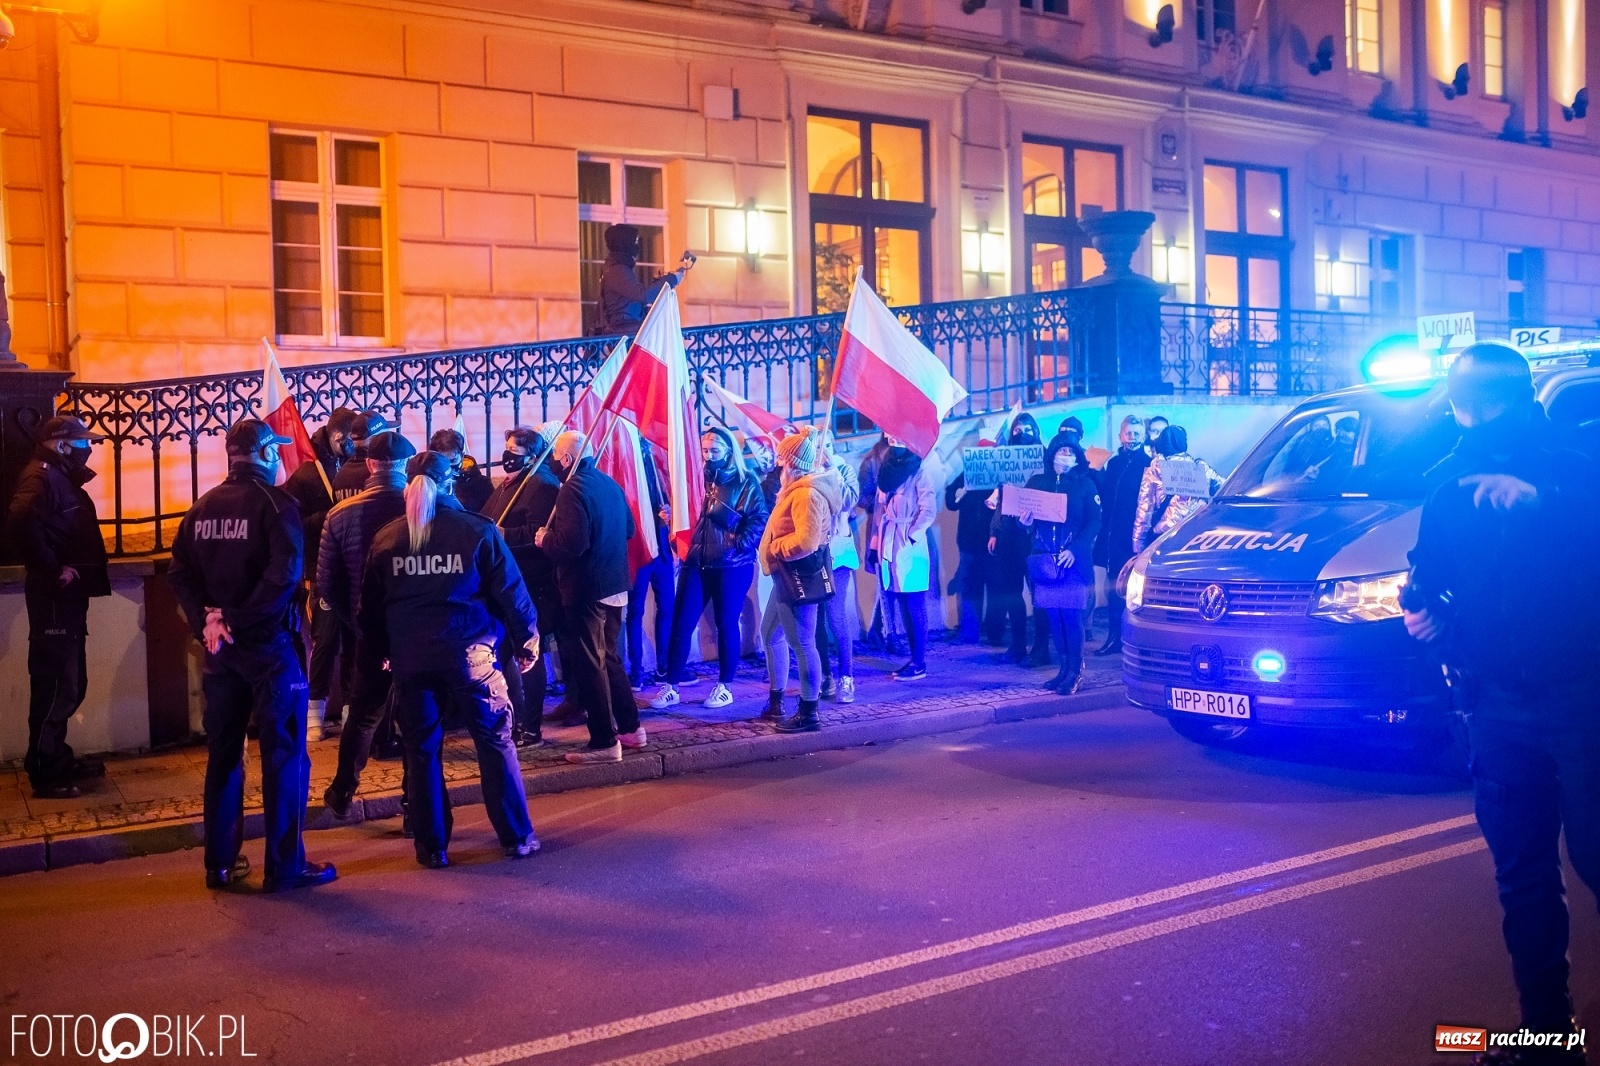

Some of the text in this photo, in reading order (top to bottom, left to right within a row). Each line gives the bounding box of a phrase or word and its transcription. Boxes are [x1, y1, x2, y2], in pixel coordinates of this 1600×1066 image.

[1422, 317, 1473, 338] WOLNA
[998, 448, 1011, 460] TO
[1014, 447, 1043, 460] TWOJA
[992, 461, 1020, 472] TWOJA
[1004, 473, 1026, 484] WINA
[195, 518, 249, 541] POLICJA
[1180, 531, 1309, 553] POLICJA
[392, 553, 464, 577] POLICJA
[1175, 690, 1201, 710] HPP
